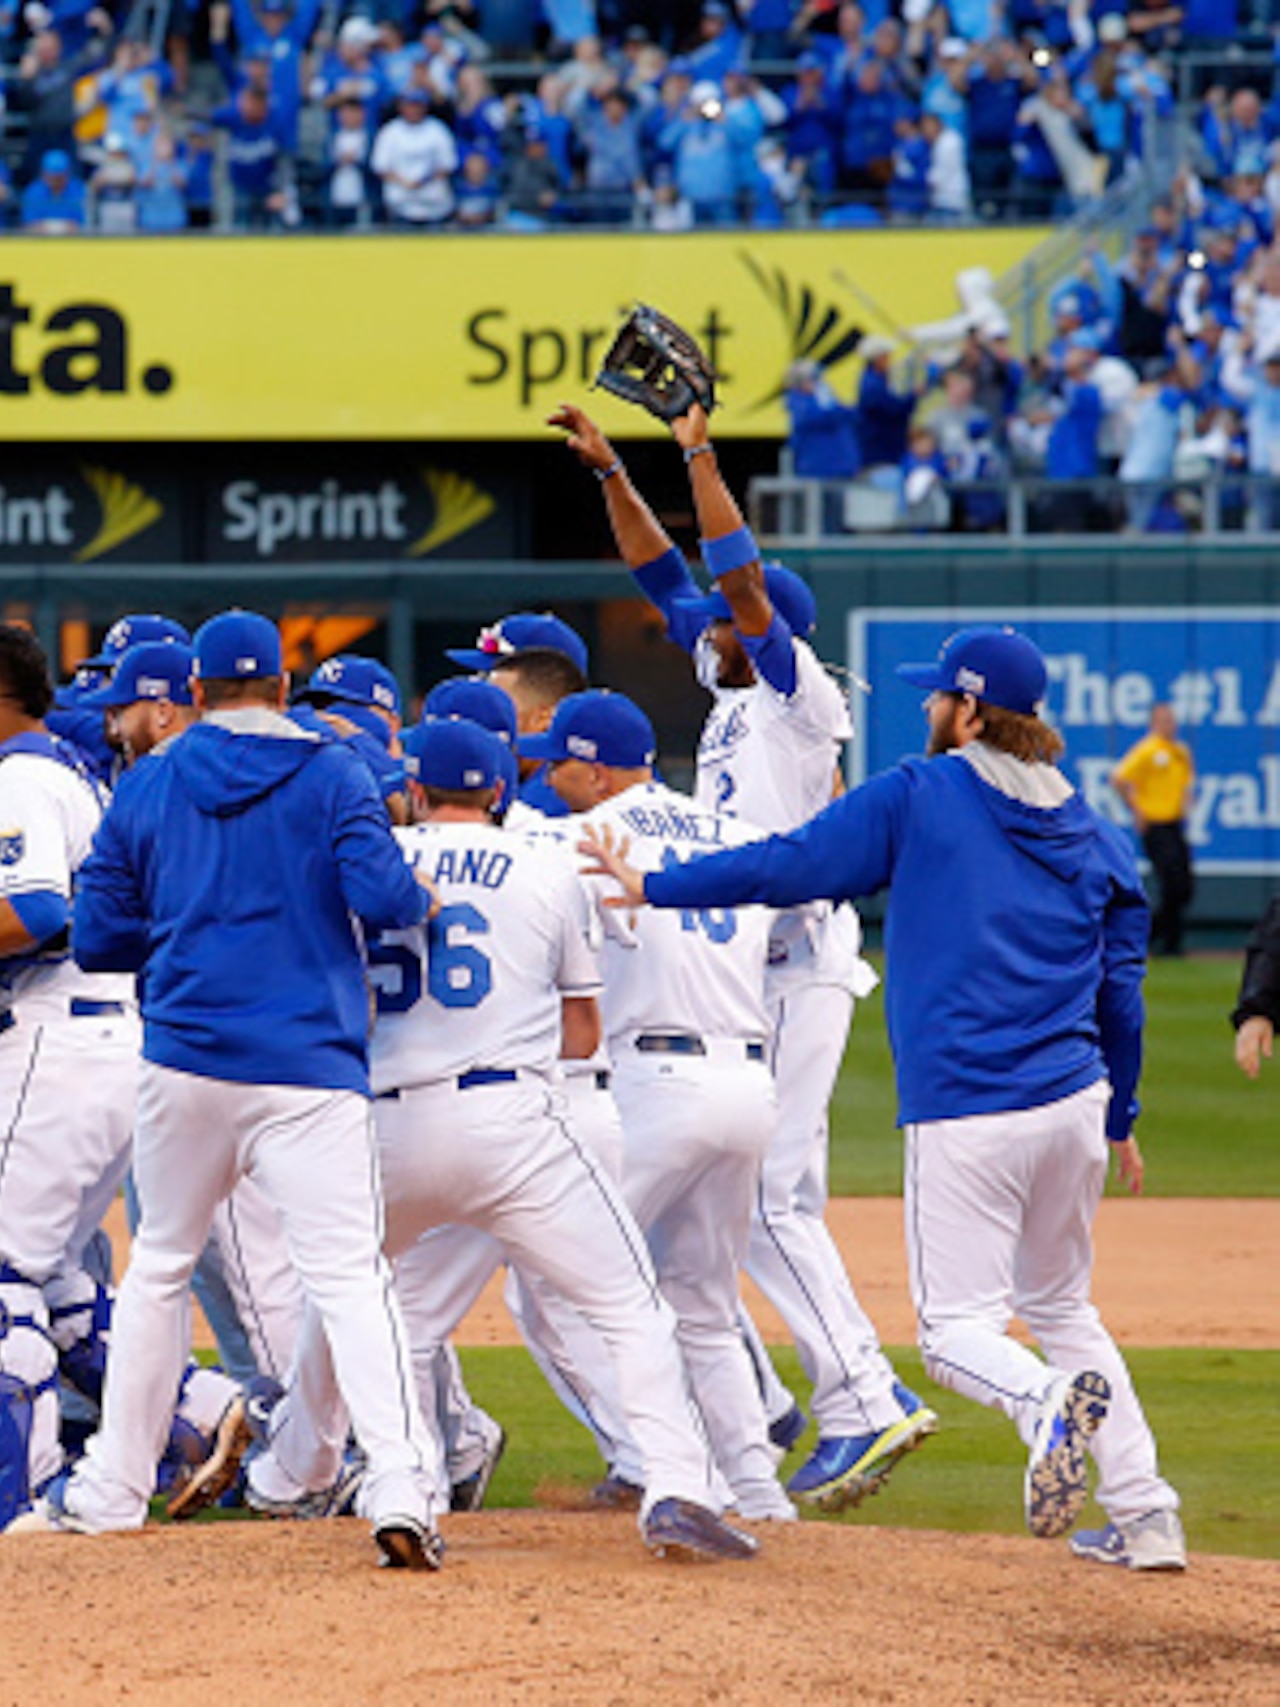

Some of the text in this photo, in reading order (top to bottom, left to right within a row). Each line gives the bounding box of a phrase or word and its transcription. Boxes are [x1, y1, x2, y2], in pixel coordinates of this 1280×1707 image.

[466, 307, 733, 407] Sprt
[222, 479, 408, 555] Sprint
[1076, 755, 1280, 846] Ryal
[365, 902, 493, 1013] 56
